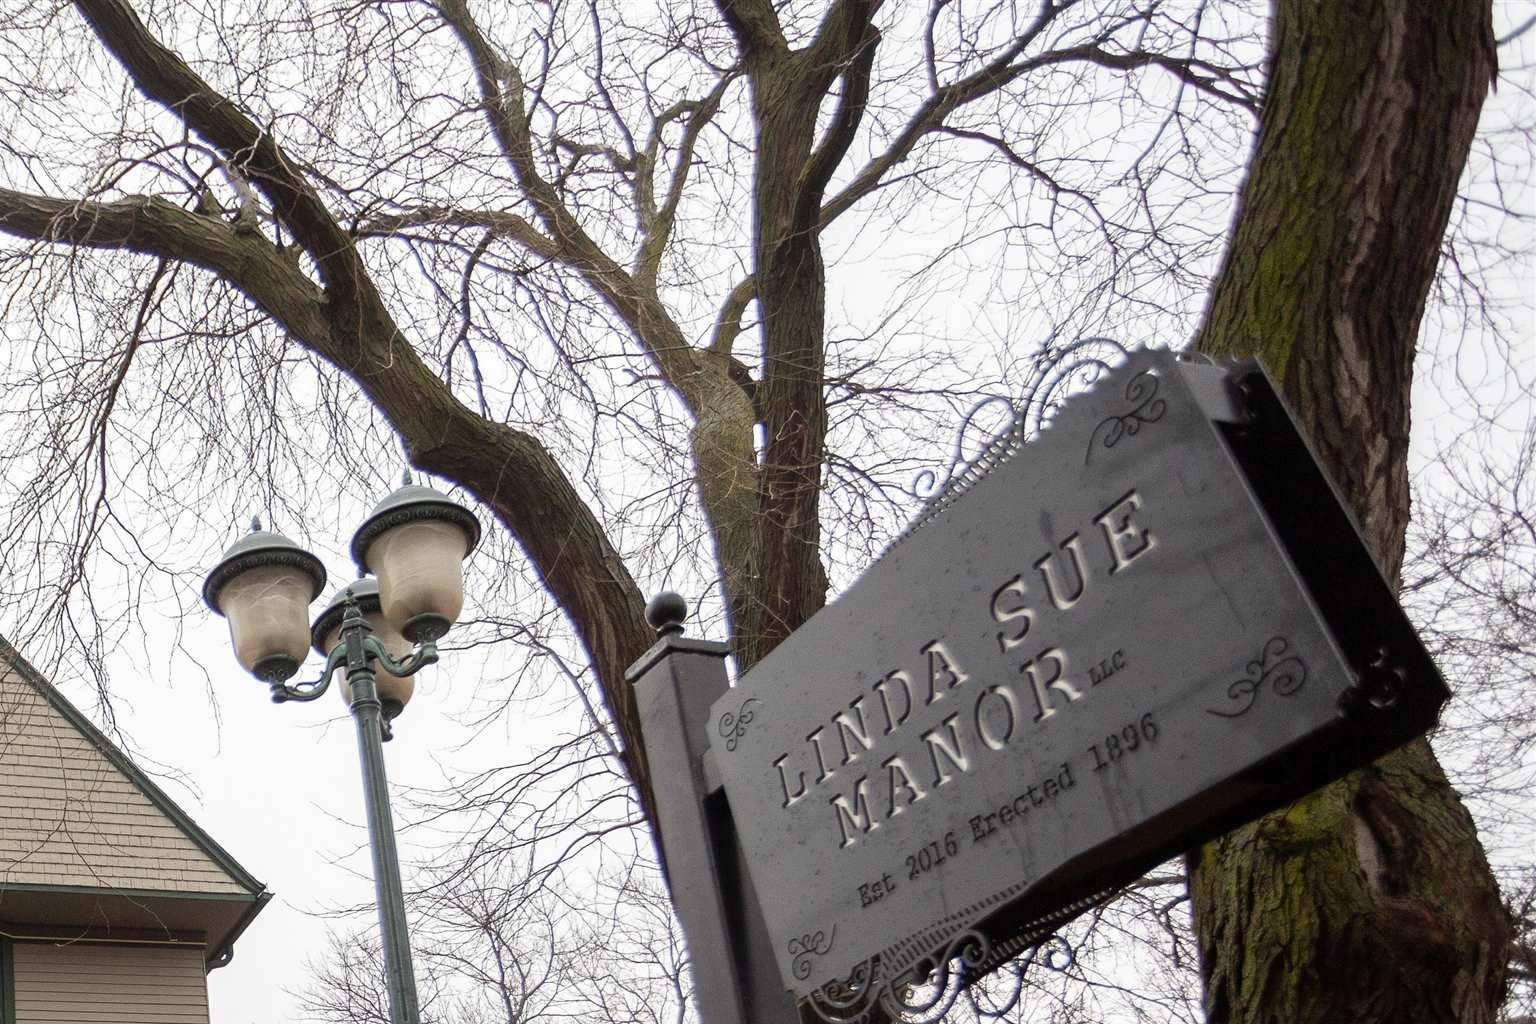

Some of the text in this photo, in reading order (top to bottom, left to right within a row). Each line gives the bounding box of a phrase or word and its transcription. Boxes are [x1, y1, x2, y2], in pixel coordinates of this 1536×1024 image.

[772, 488, 1157, 809] LINDA SUE
[828, 647, 1127, 850] MANOR LLC
[856, 712, 1159, 908] Est 2016 Erected 1896
